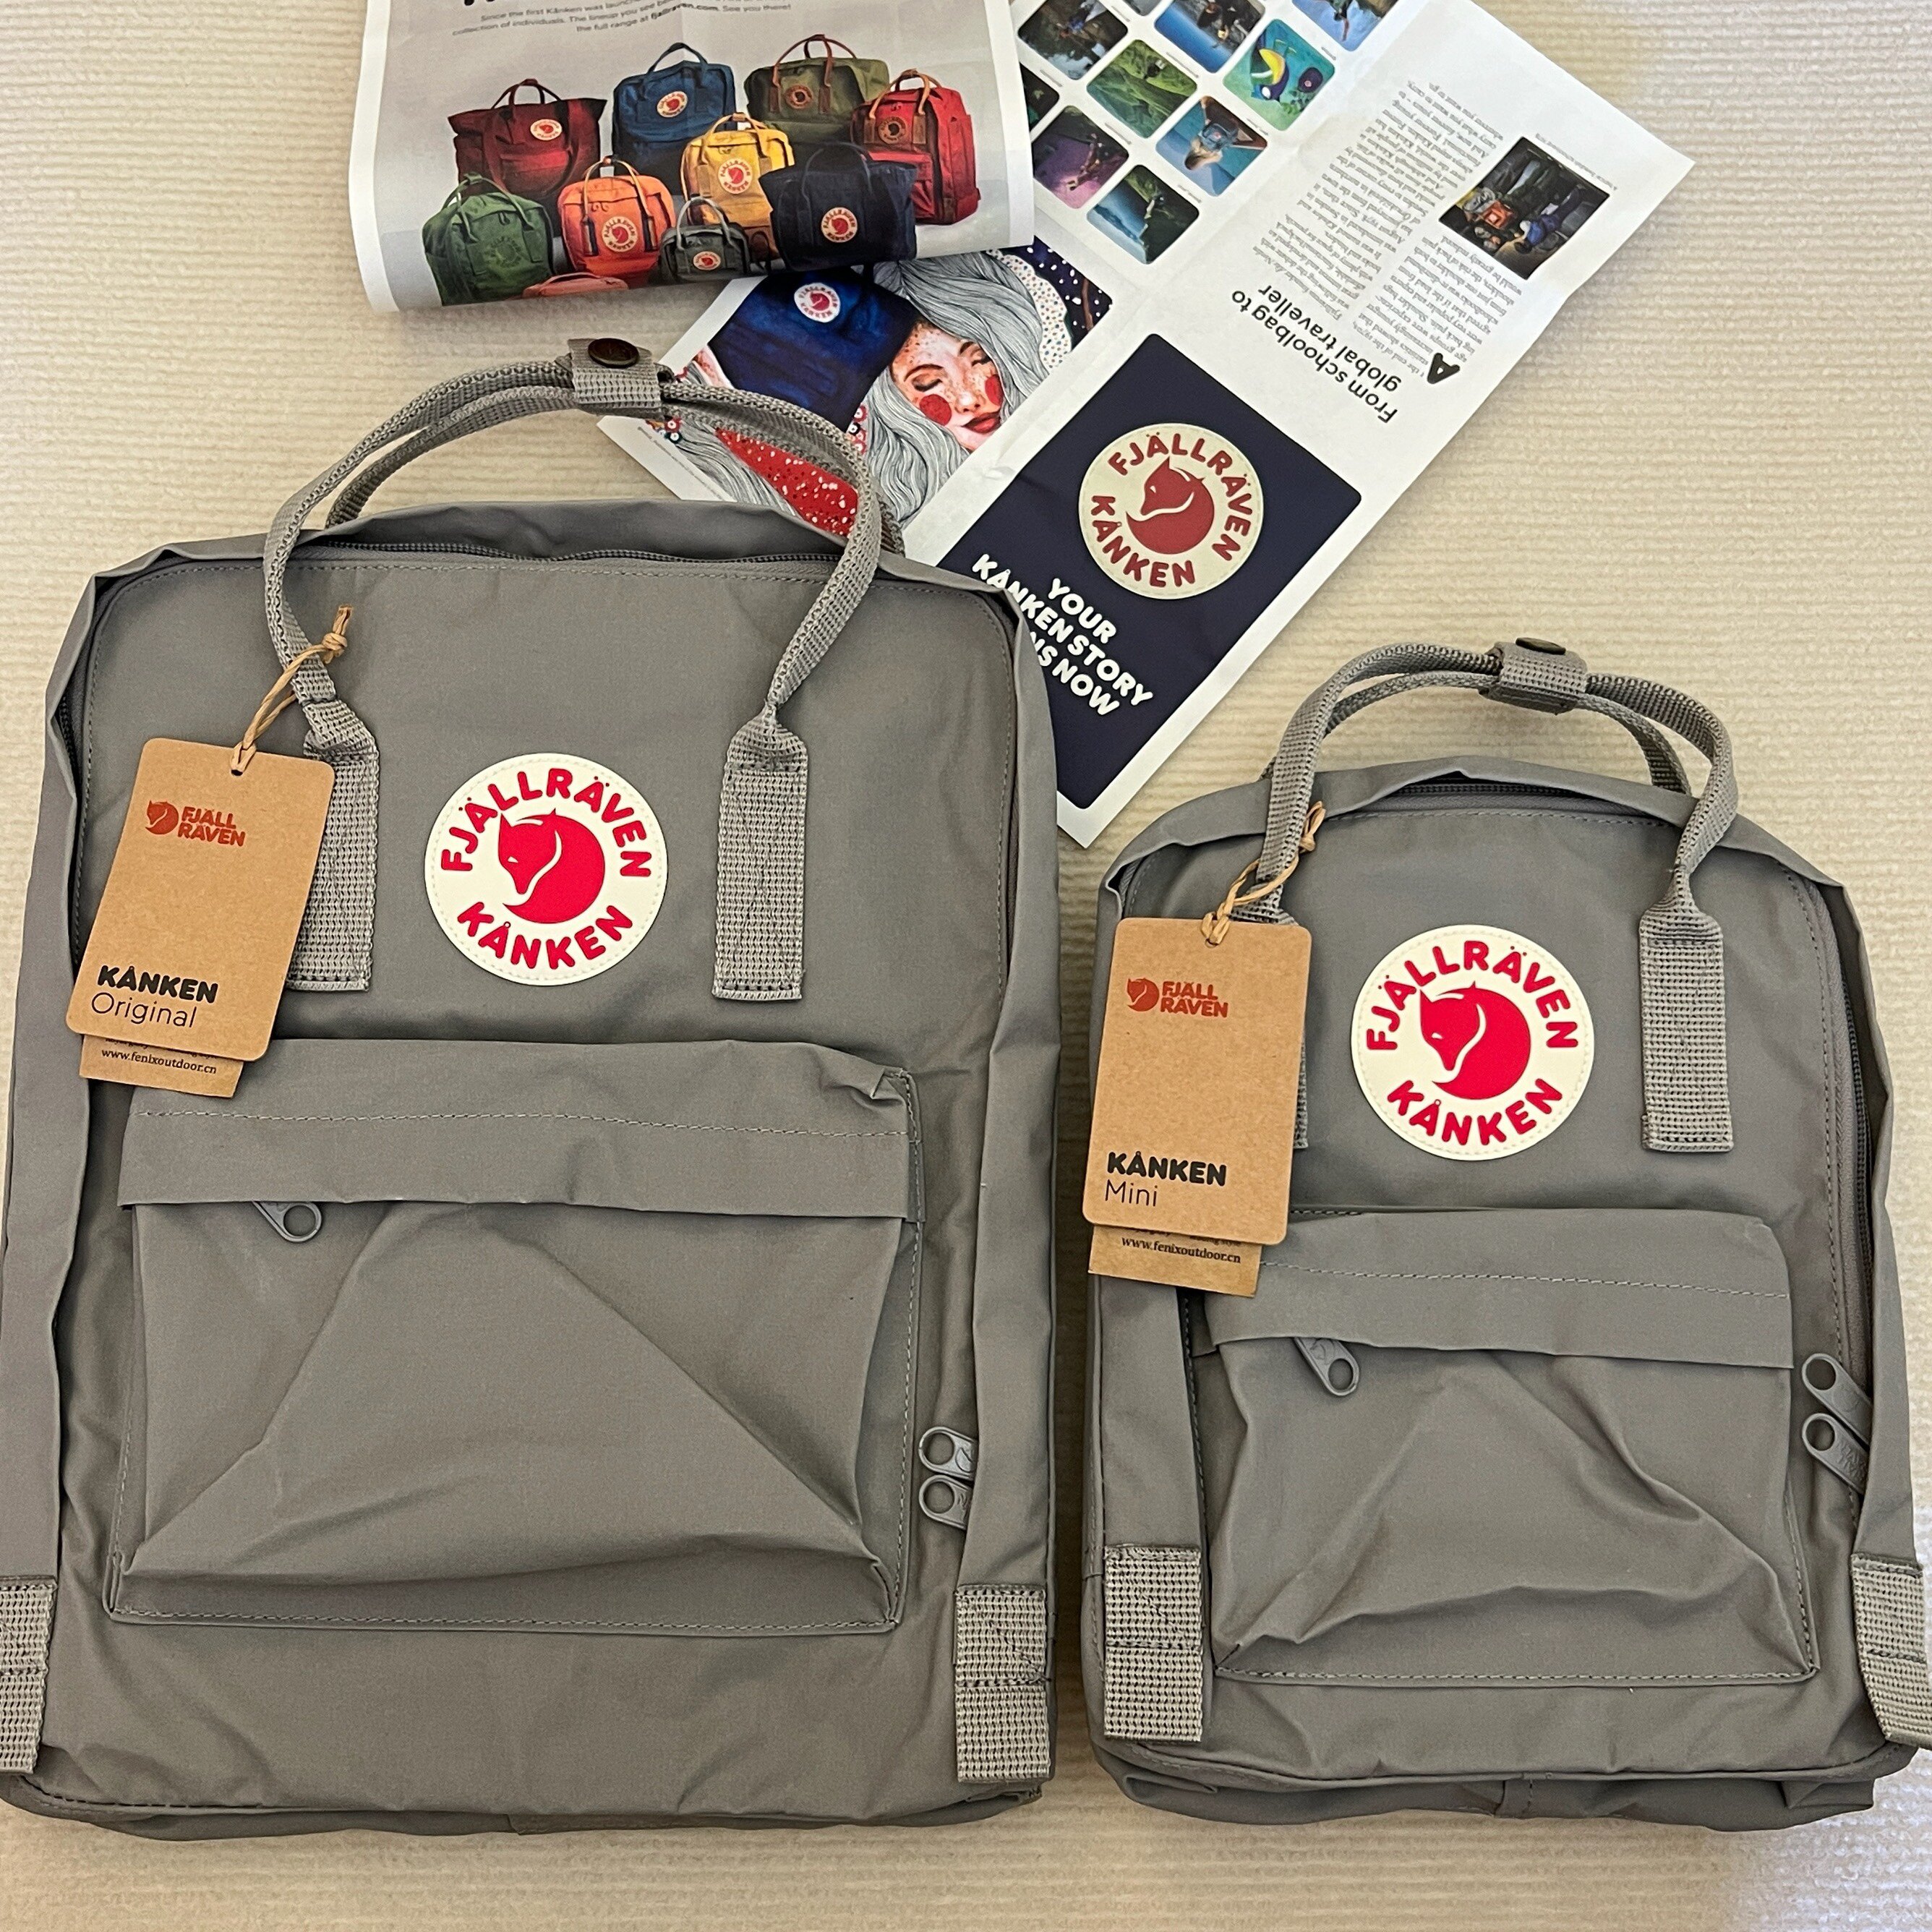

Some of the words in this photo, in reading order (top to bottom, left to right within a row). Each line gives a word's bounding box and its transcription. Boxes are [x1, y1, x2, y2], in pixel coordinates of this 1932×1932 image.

[1232, 291, 1252, 312] to
[1258, 285, 1337, 351] traveller
[1252, 304, 1348, 383] schoolbag
[1335, 346, 1402, 391] global
[1348, 380, 1398, 423] From
[1108, 432, 1253, 561] FJÄLLRÄVEN
[1090, 495, 1196, 588] KÅNKEN
[972, 554, 1074, 644] KÅNKEN
[1067, 634, 1153, 706] STORY
[1048, 578, 1116, 644] YOUR
[1052, 658, 1120, 716] NOW
[178, 822, 246, 847] RÄVEN
[181, 806, 236, 829] FJÄLL
[441, 768, 651, 877] FJÄLLRÄVEN
[457, 902, 633, 970] KÅNKEN
[92, 992, 197, 1027] Original
[98, 965, 218, 1004] KÅNKEN
[1367, 940, 1578, 1051] FJÄLLRÄVEN
[102, 1049, 217, 1074] www.fenixoutdoor.cn
[1387, 1078, 1563, 1145] KÅNKEN
[1105, 1179, 1158, 1207] Mini
[1107, 1151, 1227, 1187] KÅNKEN
[1121, 1237, 1241, 1263] www.fenixoutdoor.cn
